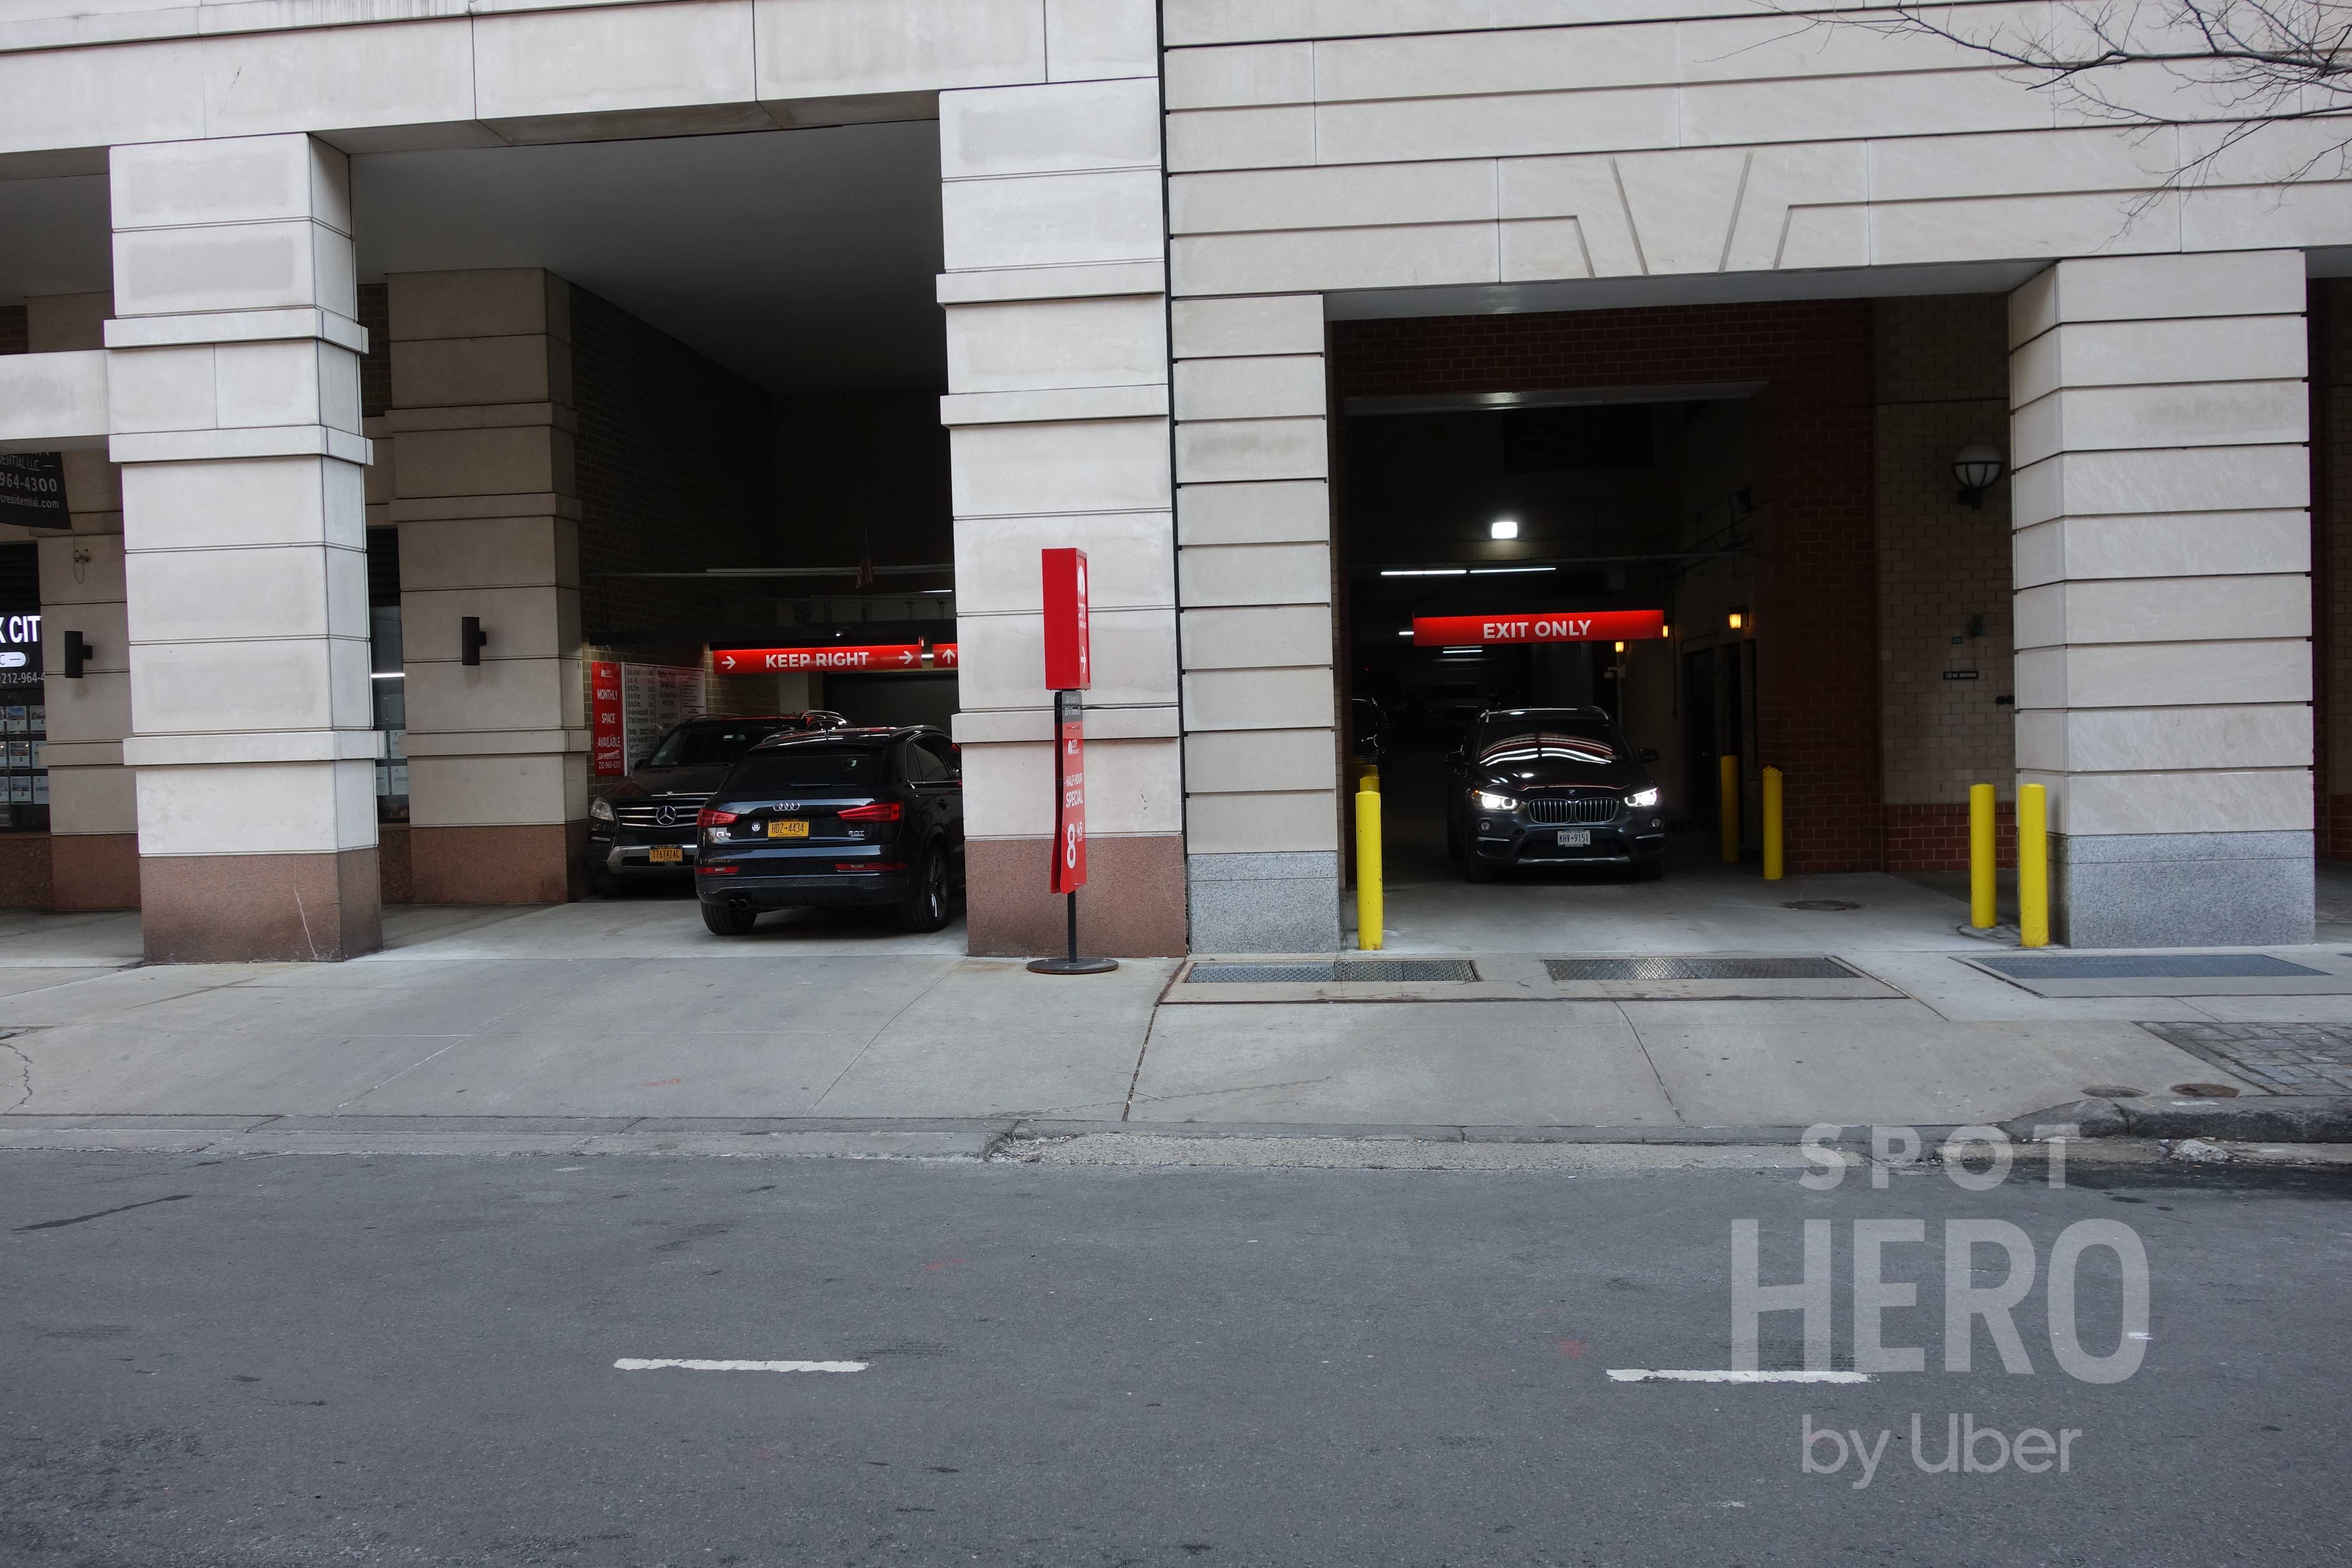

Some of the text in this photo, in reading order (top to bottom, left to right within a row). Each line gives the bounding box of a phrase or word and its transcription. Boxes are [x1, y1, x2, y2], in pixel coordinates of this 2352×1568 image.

[9, 616, 42, 643] CIT
[1483, 620, 1591, 638] EXIT ONLY
[766, 652, 869, 668] KEEP RIGHT
[597, 689, 618, 700] MONTHLY
[602, 713, 616, 724] SPACE
[598, 736, 620, 747] AVAILABLE
[1066, 774, 1074, 787] HALF
[1066, 788, 1083, 808] SPECIAL
[1077, 821, 1082, 836] 45
[1067, 823, 1076, 869] 8
